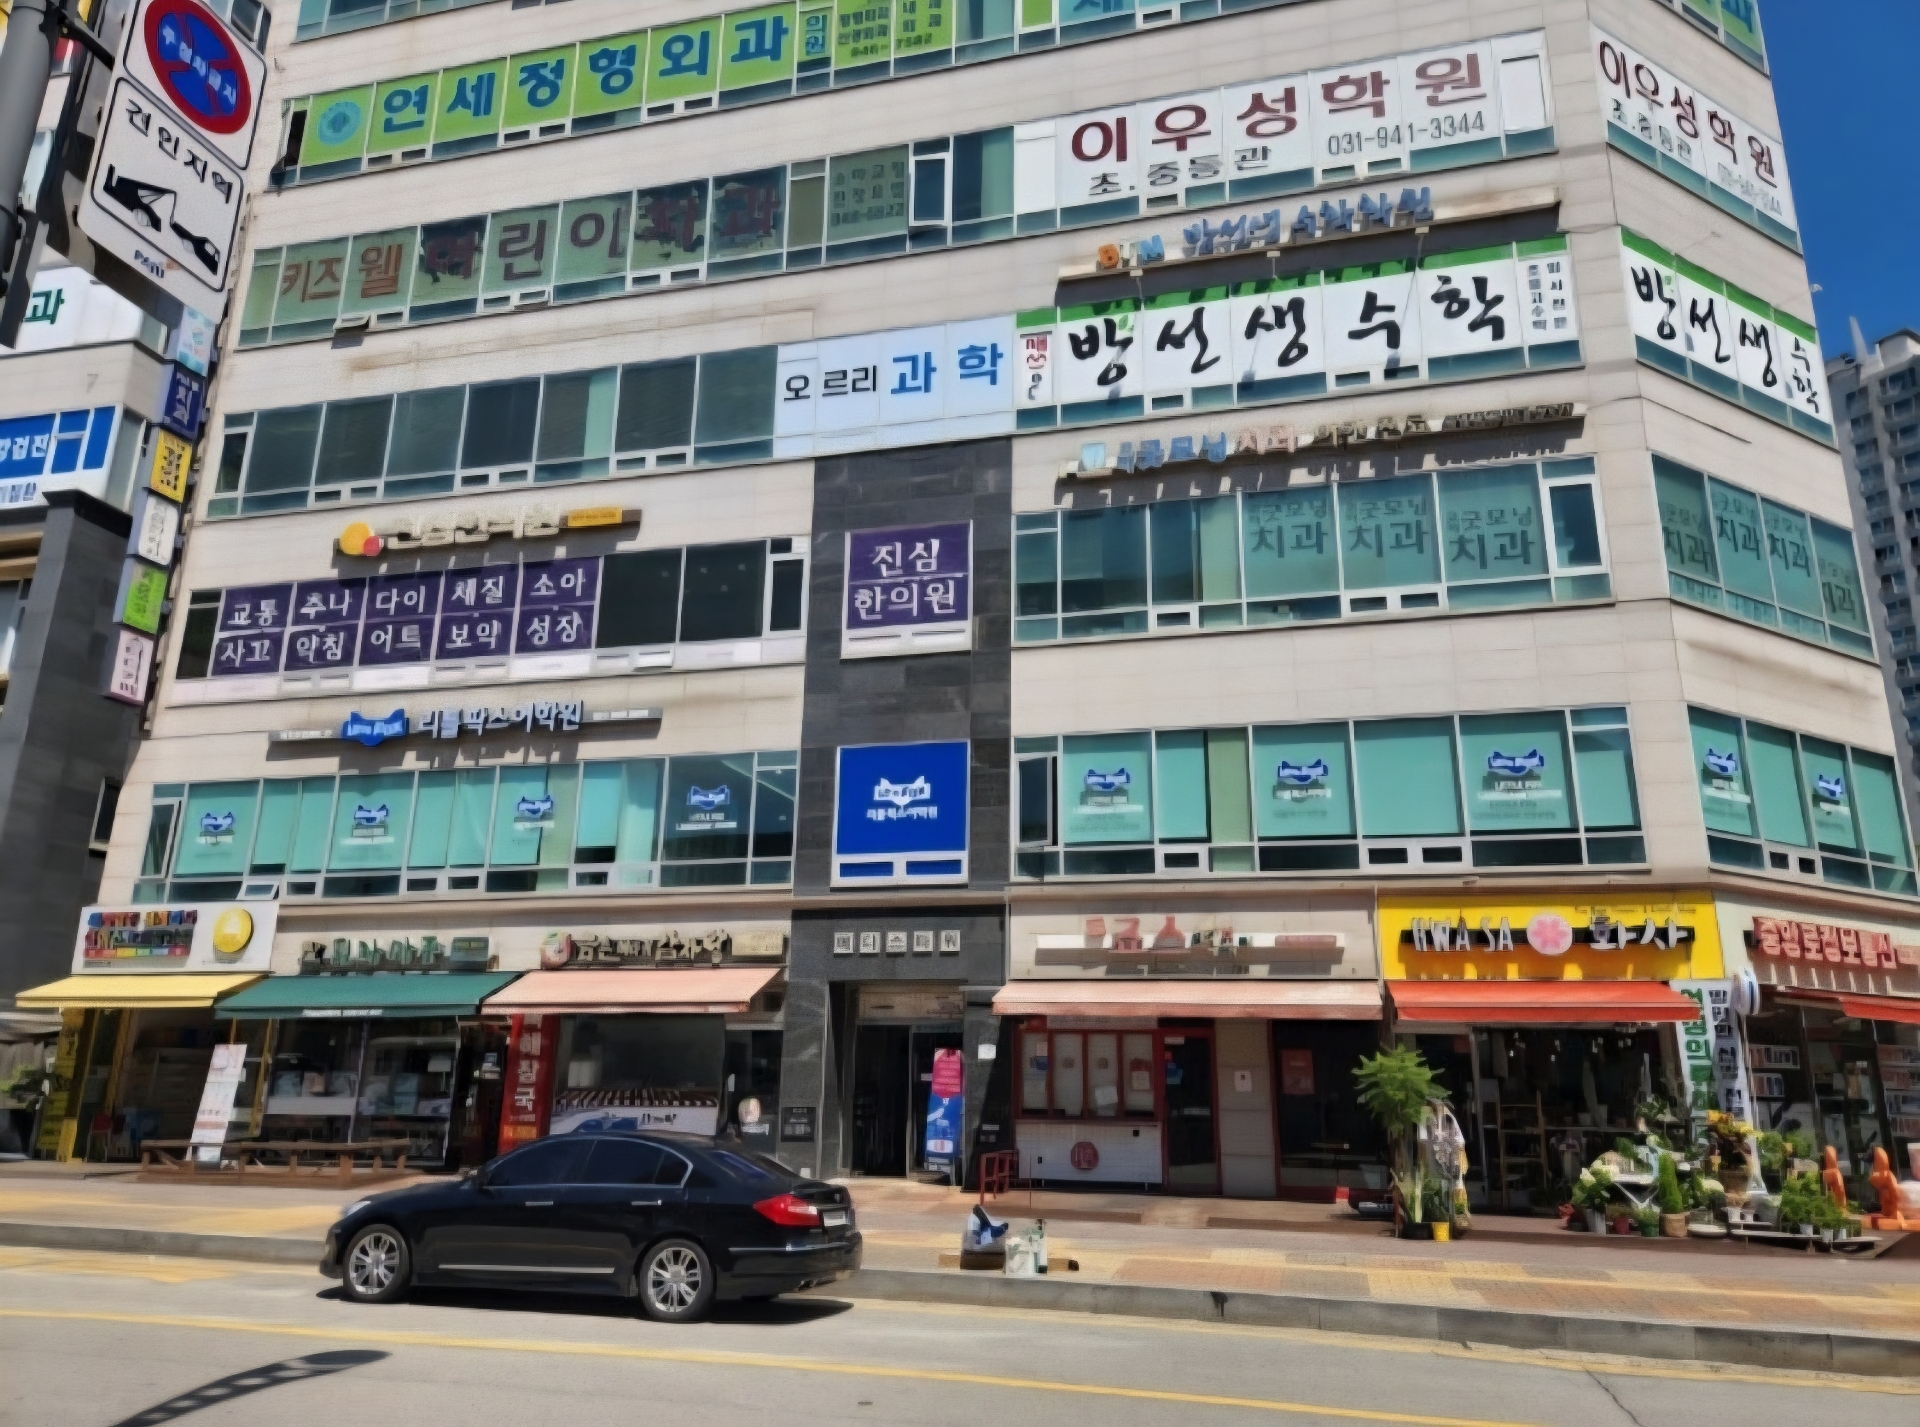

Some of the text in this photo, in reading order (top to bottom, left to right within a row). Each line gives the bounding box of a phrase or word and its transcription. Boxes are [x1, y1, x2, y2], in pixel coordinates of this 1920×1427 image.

[384, 15, 789, 133] 연세정형외과
[1071, 53, 1488, 162] 이우성학원
[1599, 40, 1778, 187] 이우성학원
[126, 98, 233, 204] 견인지역
[280, 243, 403, 303] 키즈웰
[1631, 266, 1777, 389] 방선생
[783, 365, 878, 402] 오르리
[890, 342, 1004, 395] 과학
[872, 538, 940, 577] 진심
[1250, 521, 1329, 558] 치과
[1349, 519, 1430, 558] 치과
[1450, 530, 1535, 569] 치과
[227, 599, 279, 626] 교통
[375, 585, 426, 616] 다이
[530, 568, 587, 597] 소아
[854, 579, 956, 621] 한의원
[220, 639, 271, 668] 사고
[526, 611, 583, 645] 성장
[1479, 916, 1514, 952] SA
